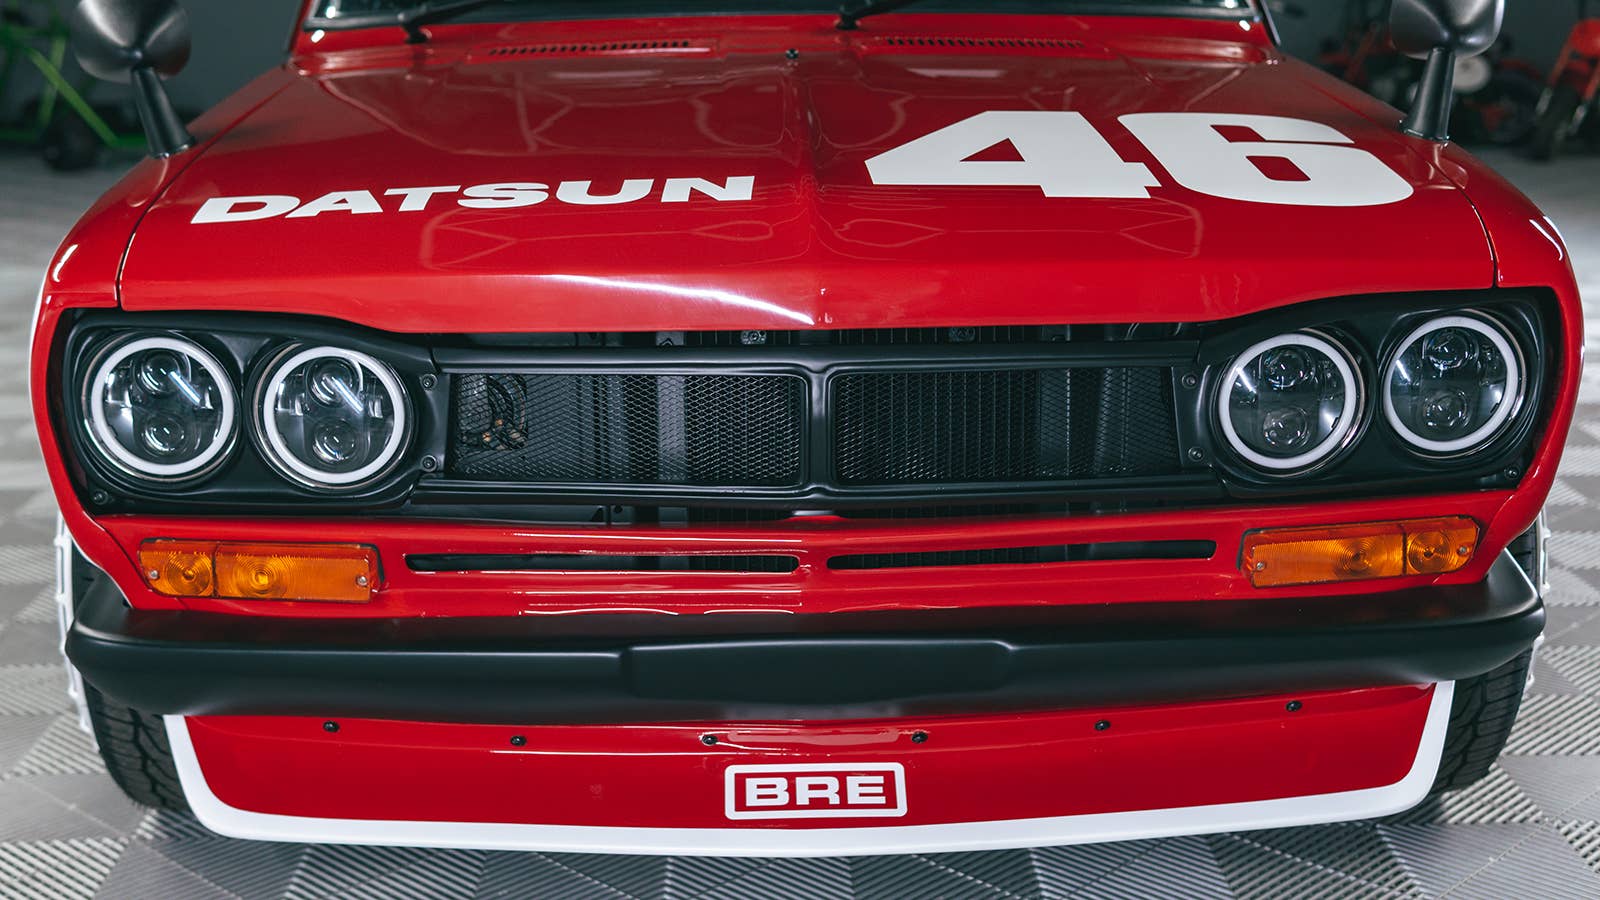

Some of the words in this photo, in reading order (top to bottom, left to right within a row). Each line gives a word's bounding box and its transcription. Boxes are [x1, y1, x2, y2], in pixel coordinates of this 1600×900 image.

[865, 110, 1414, 207] 46
[191, 175, 755, 224] DATSUN
[745, 776, 886, 807] BRE
